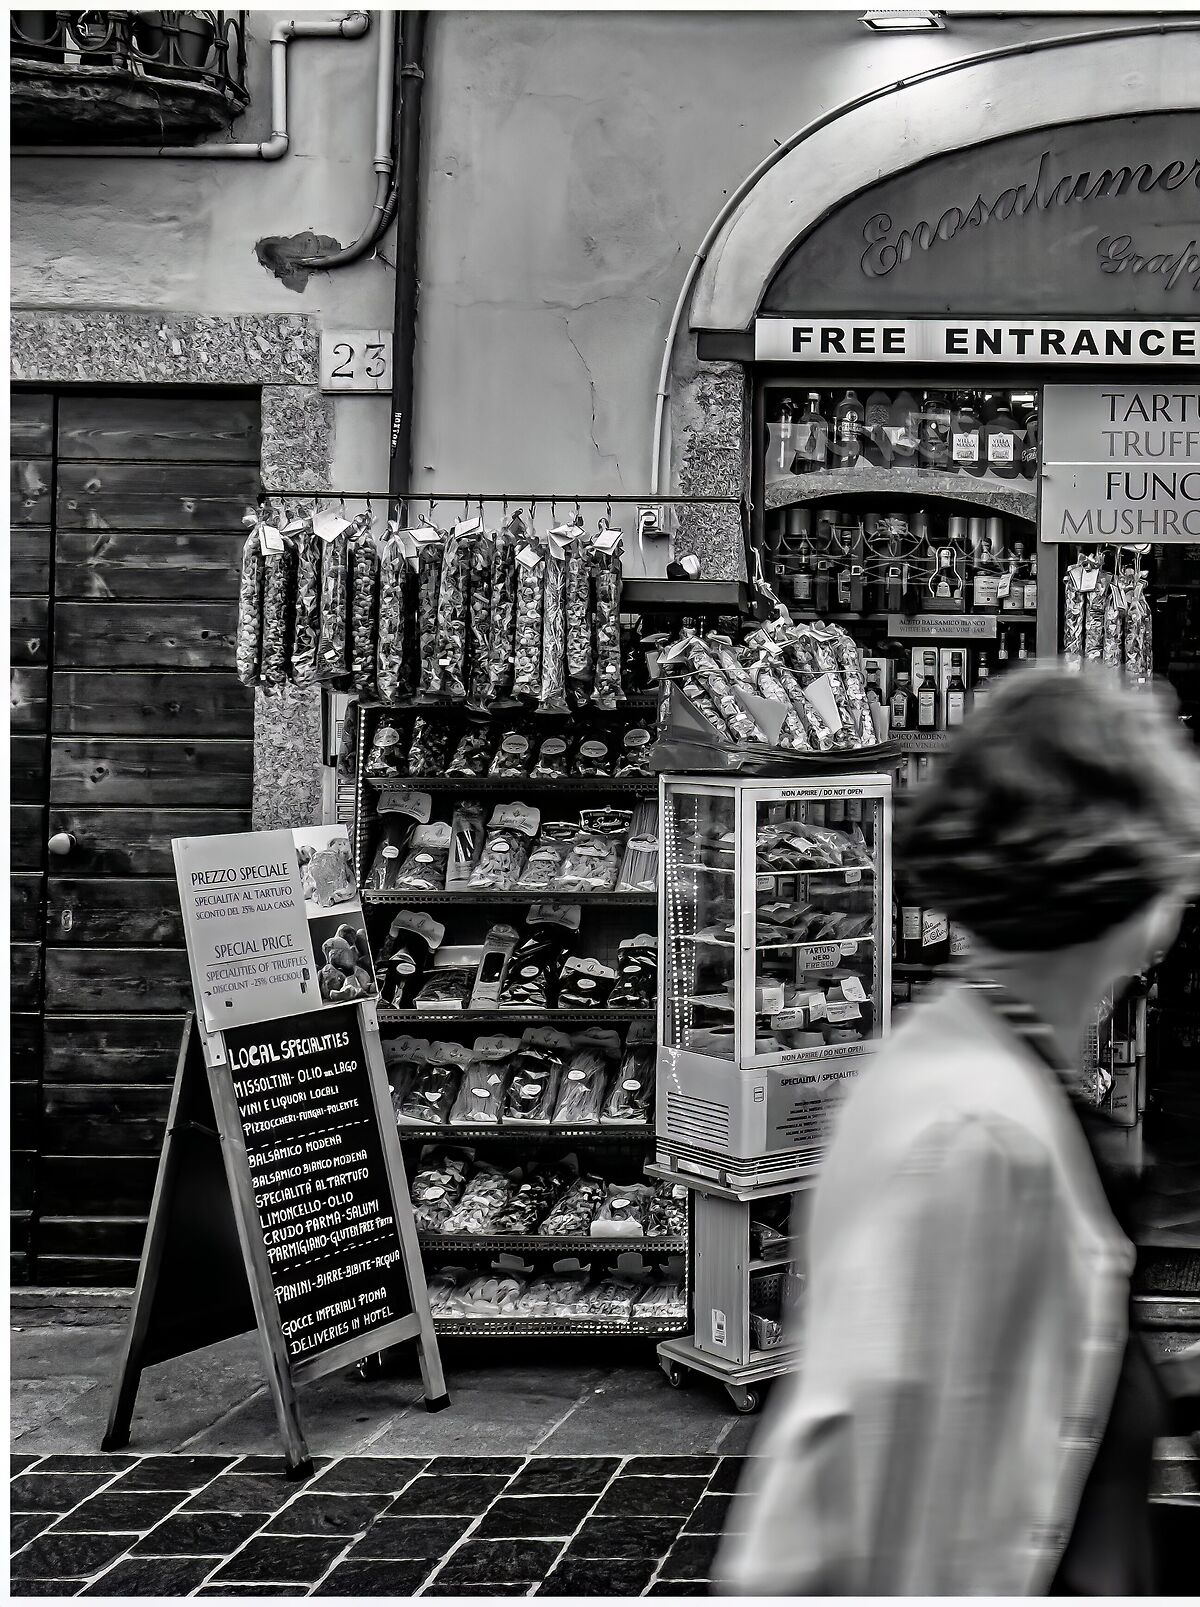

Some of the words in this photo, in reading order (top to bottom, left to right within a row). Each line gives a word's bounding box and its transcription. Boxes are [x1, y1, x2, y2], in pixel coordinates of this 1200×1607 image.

[791, 326, 906, 354] FREE
[945, 328, 1197, 357] ENTRANCE
[331, 343, 386, 379] 23
[191, 868, 237, 886] PREZZO
[239, 862, 290, 881] SPECIALE
[242, 890, 253, 900] AL
[254, 885, 292, 899] TARTUFO
[195, 908, 226, 920] SCONTO
[227, 906, 240, 916] DEL
[241, 905, 255, 914] 25%
[256, 902, 273, 912] ALLA
[273, 899, 295, 909] CASSA
[214, 939, 259, 959] SPECIAL
[262, 934, 293, 951] PRICE
[804, 946, 836, 955] TARTUFO
[206, 964, 257, 982] SPECIALITIES
[258, 961, 270, 973] OF
[271, 955, 308, 971] TRUFFLES
[805, 960, 835, 969] FRESCO
[212, 980, 249, 995] DISCOUNT
[268, 970, 304, 983] CHECKOU
[228, 1043, 281, 1071] LOCAL
[280, 1031, 350, 1059] SPECIALITIES
[781, 1054, 796, 1062] NON
[796, 1051, 818, 1059] APRIRE
[834, 1047, 846, 1055] NOT
[847, 1045, 864, 1053] OPEN
[297, 1066, 323, 1083] OLIO
[333, 1060, 358, 1075] LAGO
[239, 1101, 262, 1118] VINI
[263, 1099, 271, 1112] E
[271, 1091, 307, 1110] LIQUORI
[309, 1085, 340, 1100] LOCALI
[247, 1144, 303, 1168] BALSAMICO
[305, 1134, 343, 1153] MODENA
[251, 1166, 302, 1189] BALSAMICO
[302, 1158, 333, 1174] BIANCO
[333, 1149, 368, 1168] MODENA
[315, 1179, 327, 1192] AL
[326, 1167, 369, 1188] TARTUFO
[263, 1223, 304, 1246] CRUDO
[359, 1219, 375, 1235] FREE
[281, 1313, 315, 1339] GOCCE
[315, 1297, 357, 1322] IMPERIALI
[358, 1286, 387, 1306] PIONA
[289, 1321, 349, 1355] DELIVERIES
[351, 1316, 360, 1331] IN
[363, 1306, 394, 1326] HOTEL
